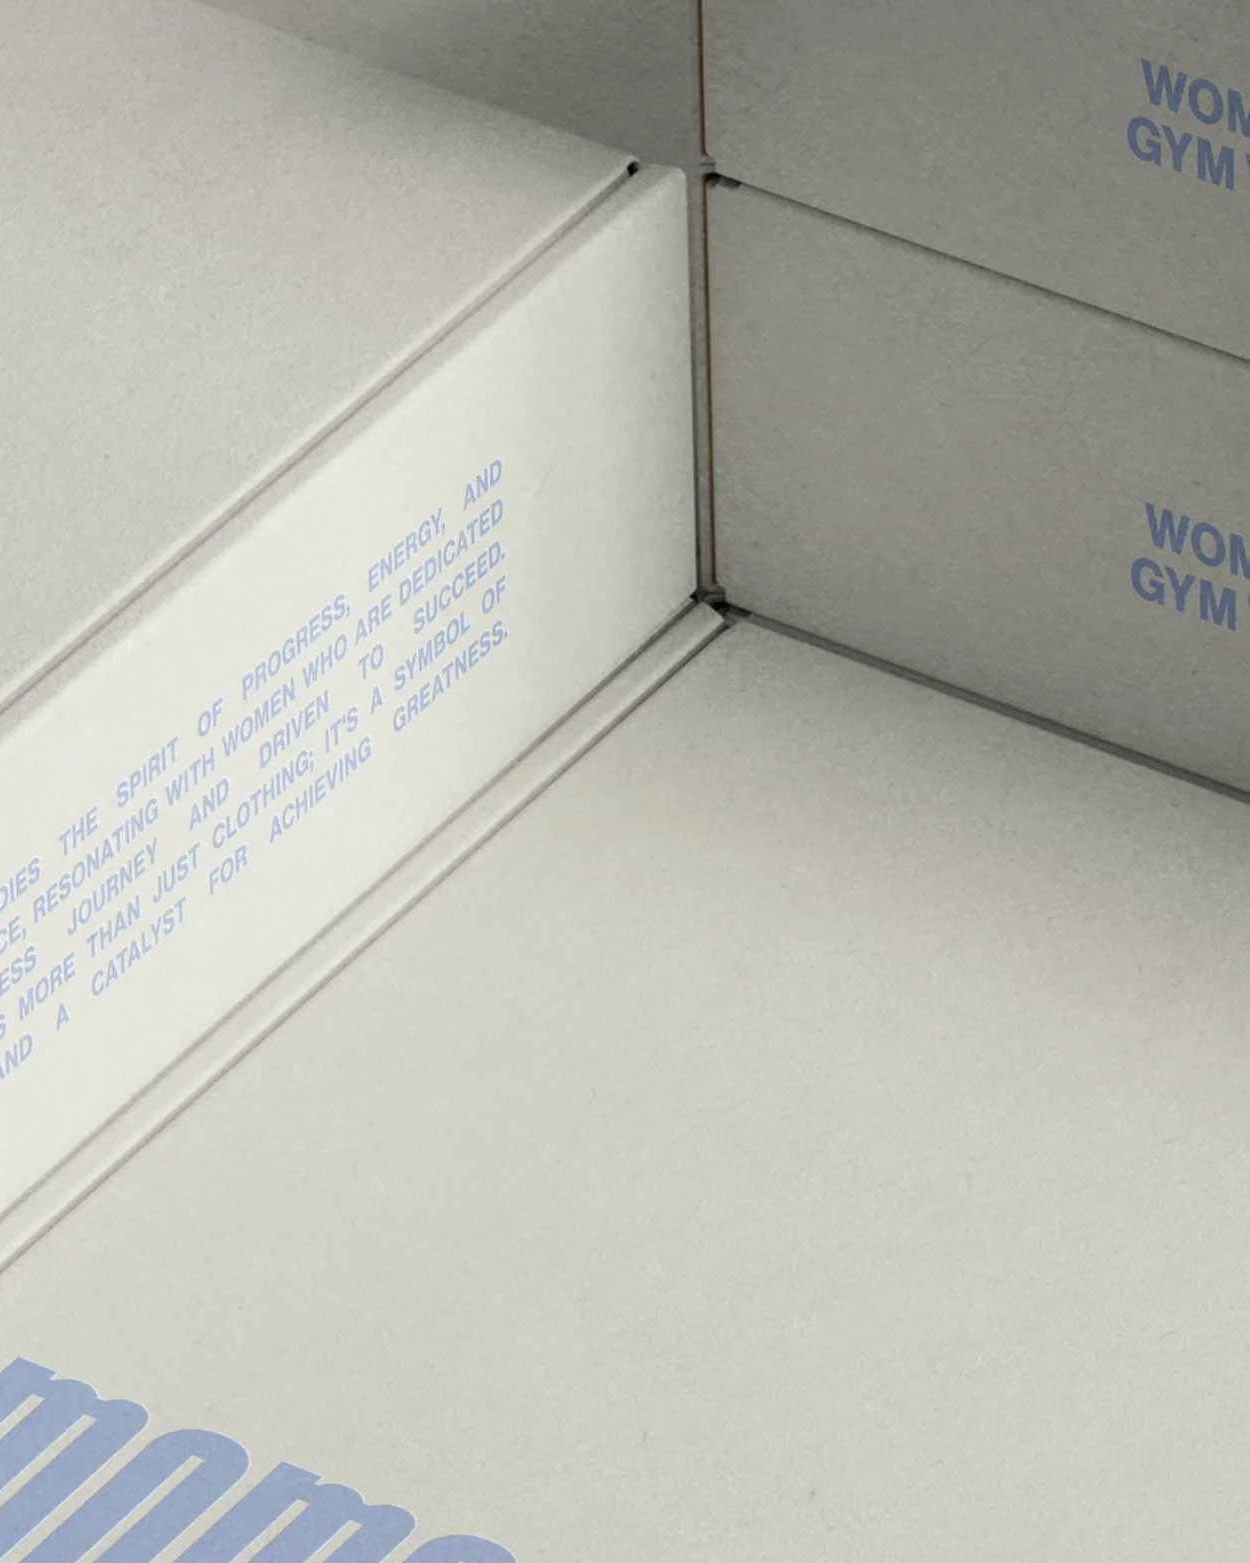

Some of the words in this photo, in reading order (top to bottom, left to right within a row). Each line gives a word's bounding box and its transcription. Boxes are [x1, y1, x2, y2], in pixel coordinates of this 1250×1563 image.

[1127, 116, 1236, 191] GYM
[32, 798, 160, 924] RESONATING
[165, 753, 217, 806] WITH
[222, 681, 298, 759] WOMEN
[301, 634, 348, 687] WHO
[354, 593, 392, 643] ARE
[398, 497, 505, 606] DEDICATED
[60, 807, 99, 855] THE
[116, 736, 178, 809] SPIRIT
[195, 699, 222, 739] OF
[240, 592, 350, 701] PROGRESS,
[367, 508, 446, 594] ENERGY,
[461, 458, 503, 513] AND
[66, 843, 156, 936] JOURNEY
[187, 778, 230, 831] AND
[258, 690, 330, 770] DRIVEN
[358, 642, 384, 679] TO
[412, 541, 504, 636] SUCCEED.
[1131, 556, 1237, 632] GYM
[17, 952, 75, 1021] MORE
[86, 896, 142, 958] THAN
[150, 843, 199, 905] JUST
[211, 750, 314, 850] CLOTHING;
[323, 708, 360, 751] IT'S
[368, 687, 386, 714] A
[391, 615, 471, 693] SYMBOL
[480, 576, 506, 616] OF
[55, 1001, 70, 1030] A
[89, 897, 185, 996] CATALYST
[207, 843, 249, 895] FOR
[269, 736, 372, 842] ACHIEVING
[392, 619, 507, 734] GREATNESS.
